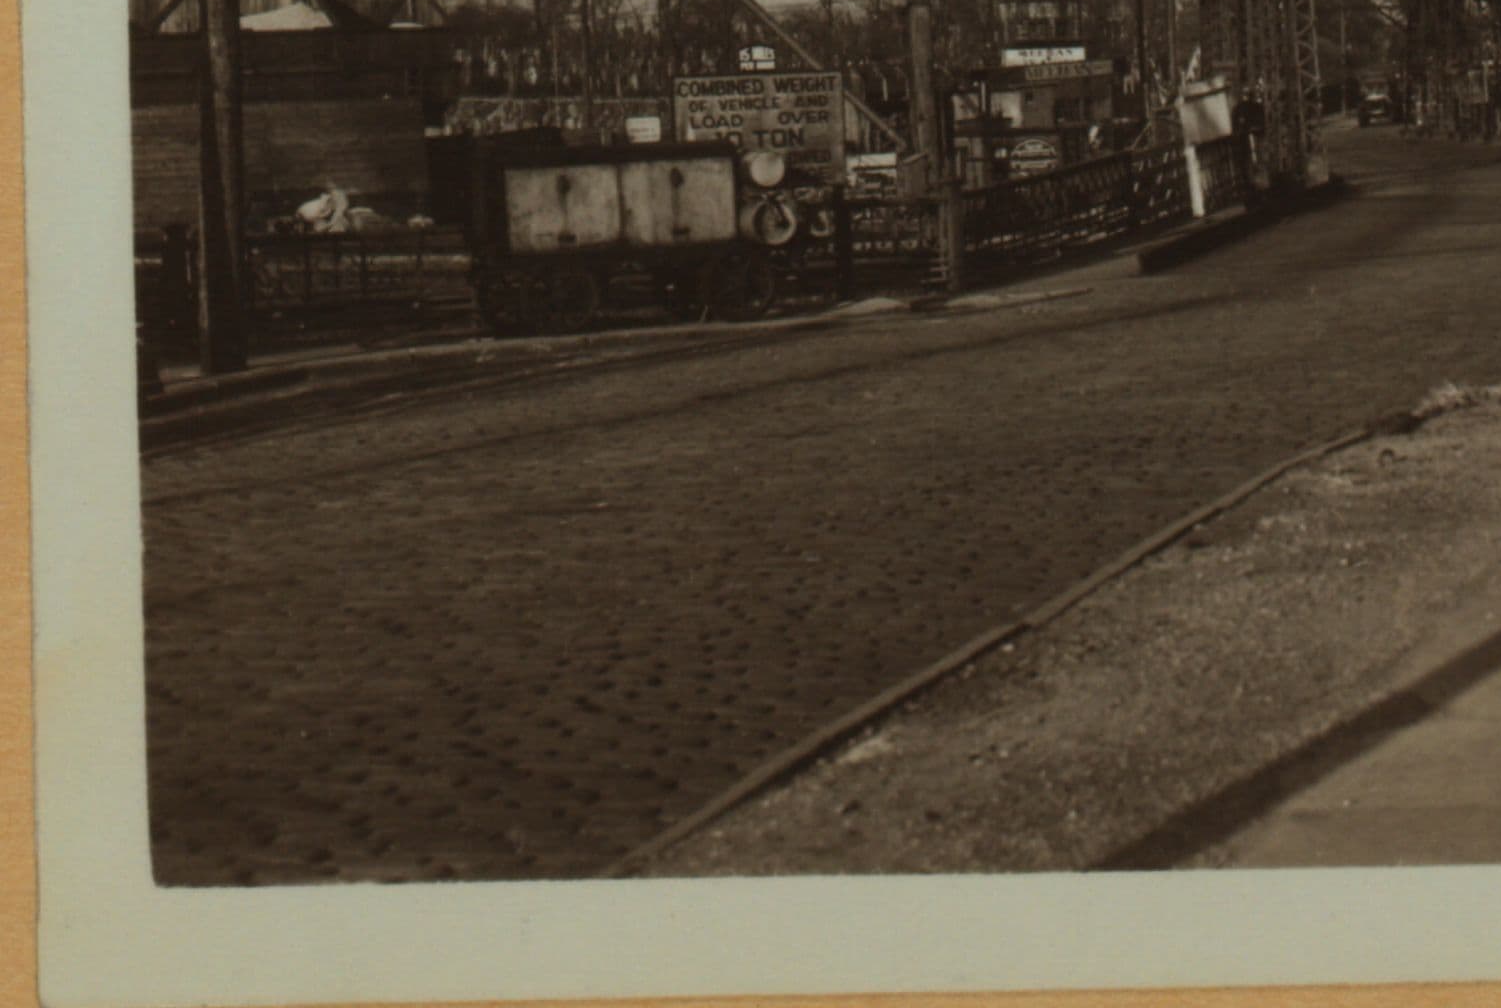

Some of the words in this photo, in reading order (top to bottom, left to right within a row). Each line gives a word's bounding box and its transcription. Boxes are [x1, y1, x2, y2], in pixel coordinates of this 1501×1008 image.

[678, 78, 764, 97] COMBINED
[774, 76, 835, 93] WEIGHT
[688, 100, 707, 113] OF
[718, 97, 781, 111] VEHICLE
[794, 95, 828, 108] AND
[689, 114, 744, 129] LOAD
[777, 110, 830, 125] OVER
[752, 128, 805, 149] TON
